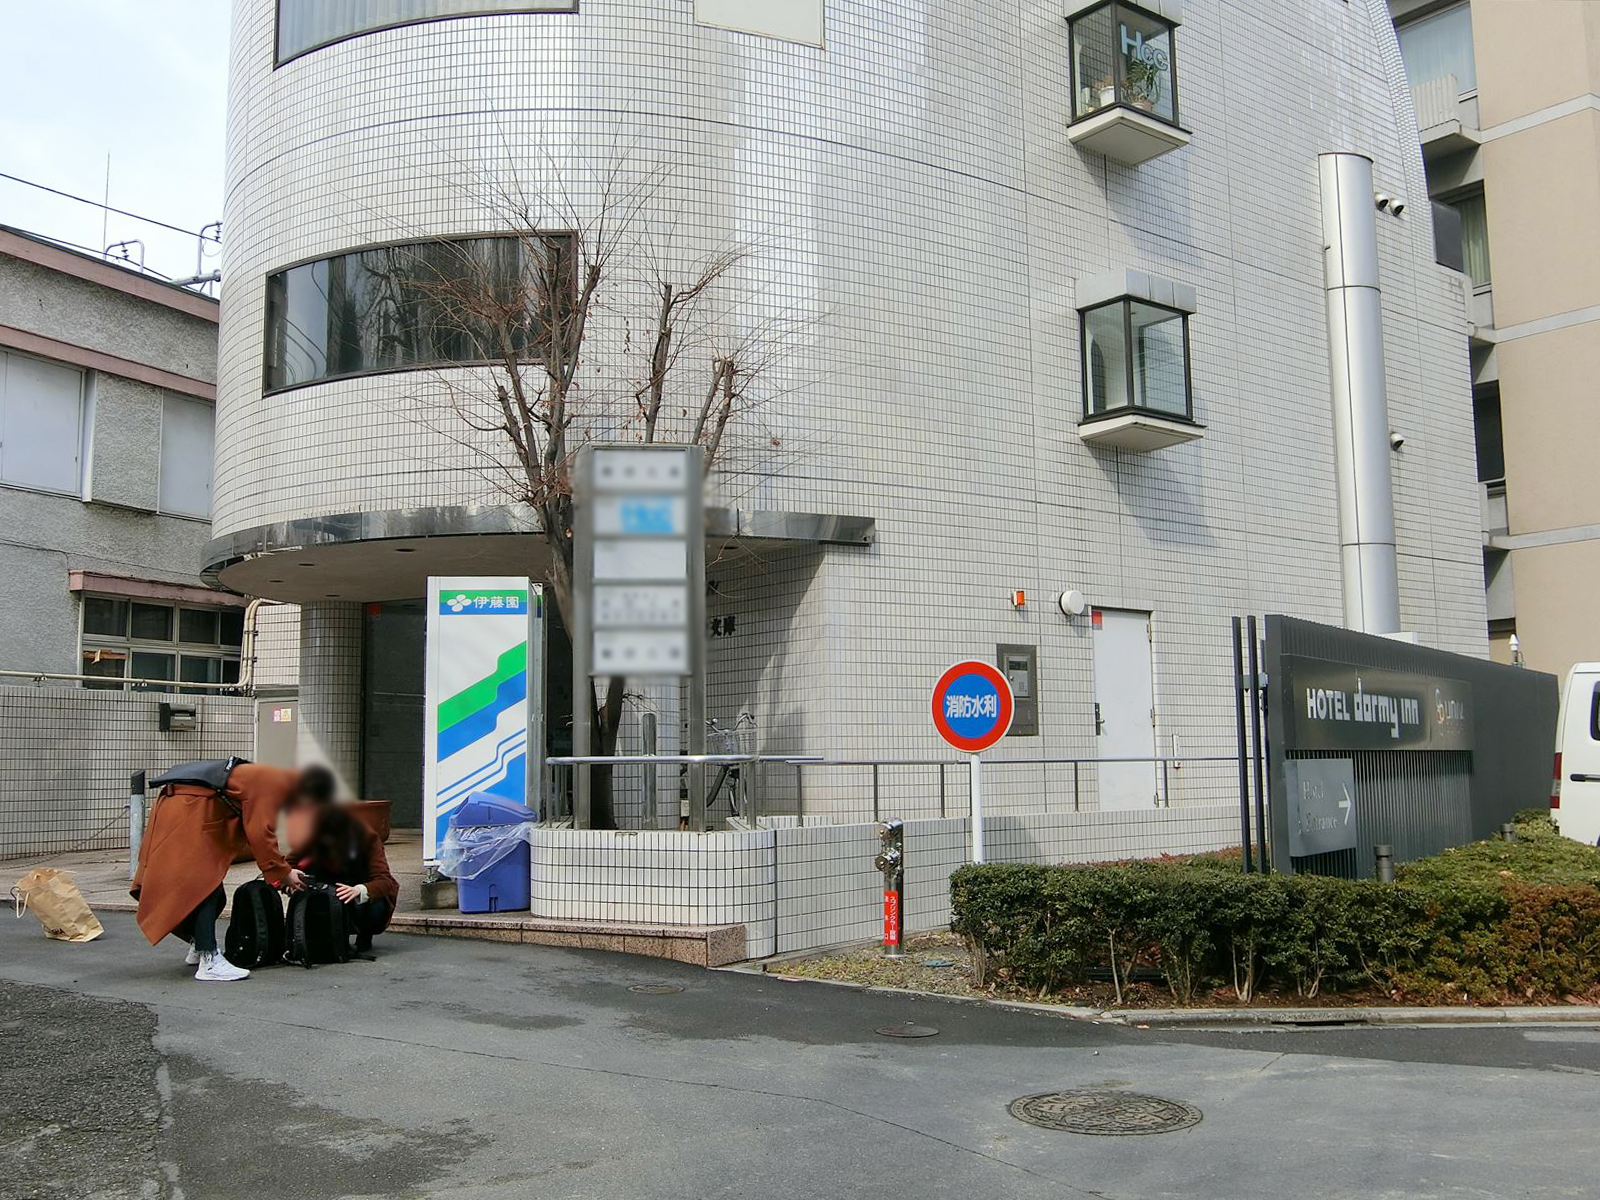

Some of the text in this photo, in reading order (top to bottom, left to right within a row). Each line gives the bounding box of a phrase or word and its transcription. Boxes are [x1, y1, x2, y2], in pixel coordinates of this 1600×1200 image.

[473, 595, 520, 609] 伊藤園
[946, 694, 997, 718] 消防水利
[1306, 687, 1351, 722] HOTEL
[1353, 677, 1400, 738] dormy
